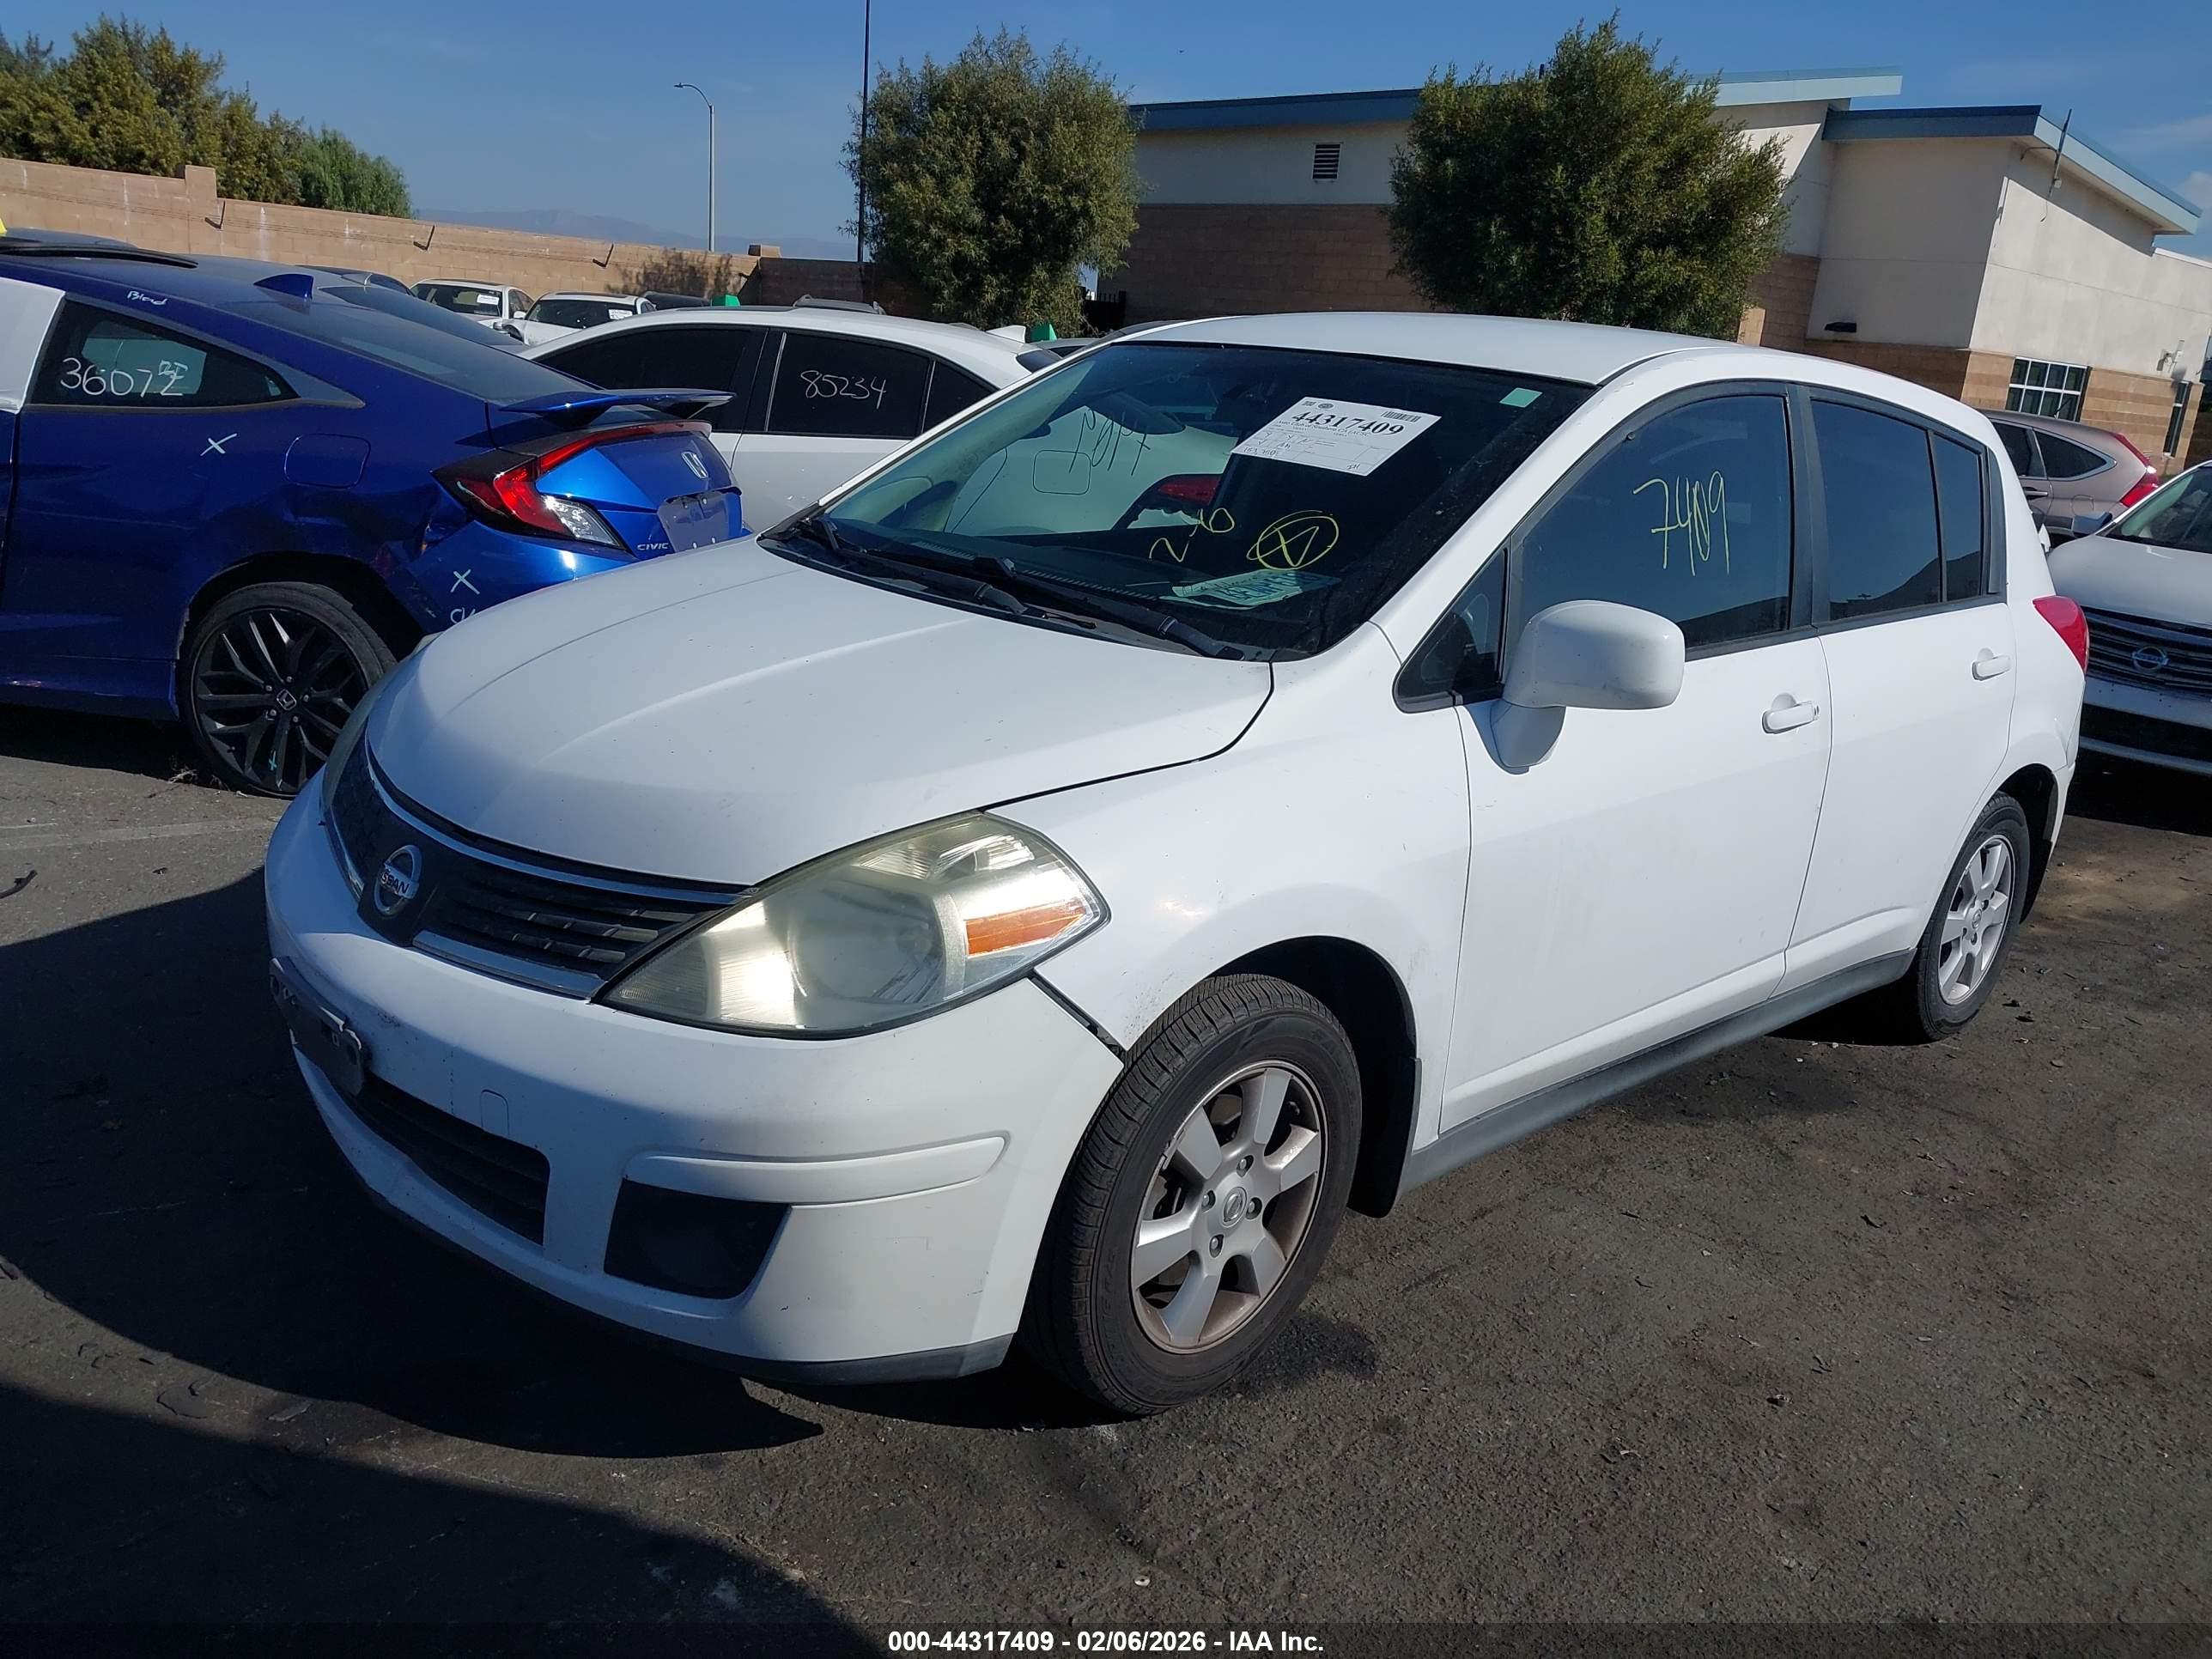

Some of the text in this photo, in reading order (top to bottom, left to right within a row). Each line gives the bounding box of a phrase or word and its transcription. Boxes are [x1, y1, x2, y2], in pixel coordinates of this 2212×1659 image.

[800, 369, 887, 410] 85234
[1291, 410, 1405, 436] 44317409
[1632, 470, 1730, 577] 7409
[636, 542, 669, 550] CIVIC
